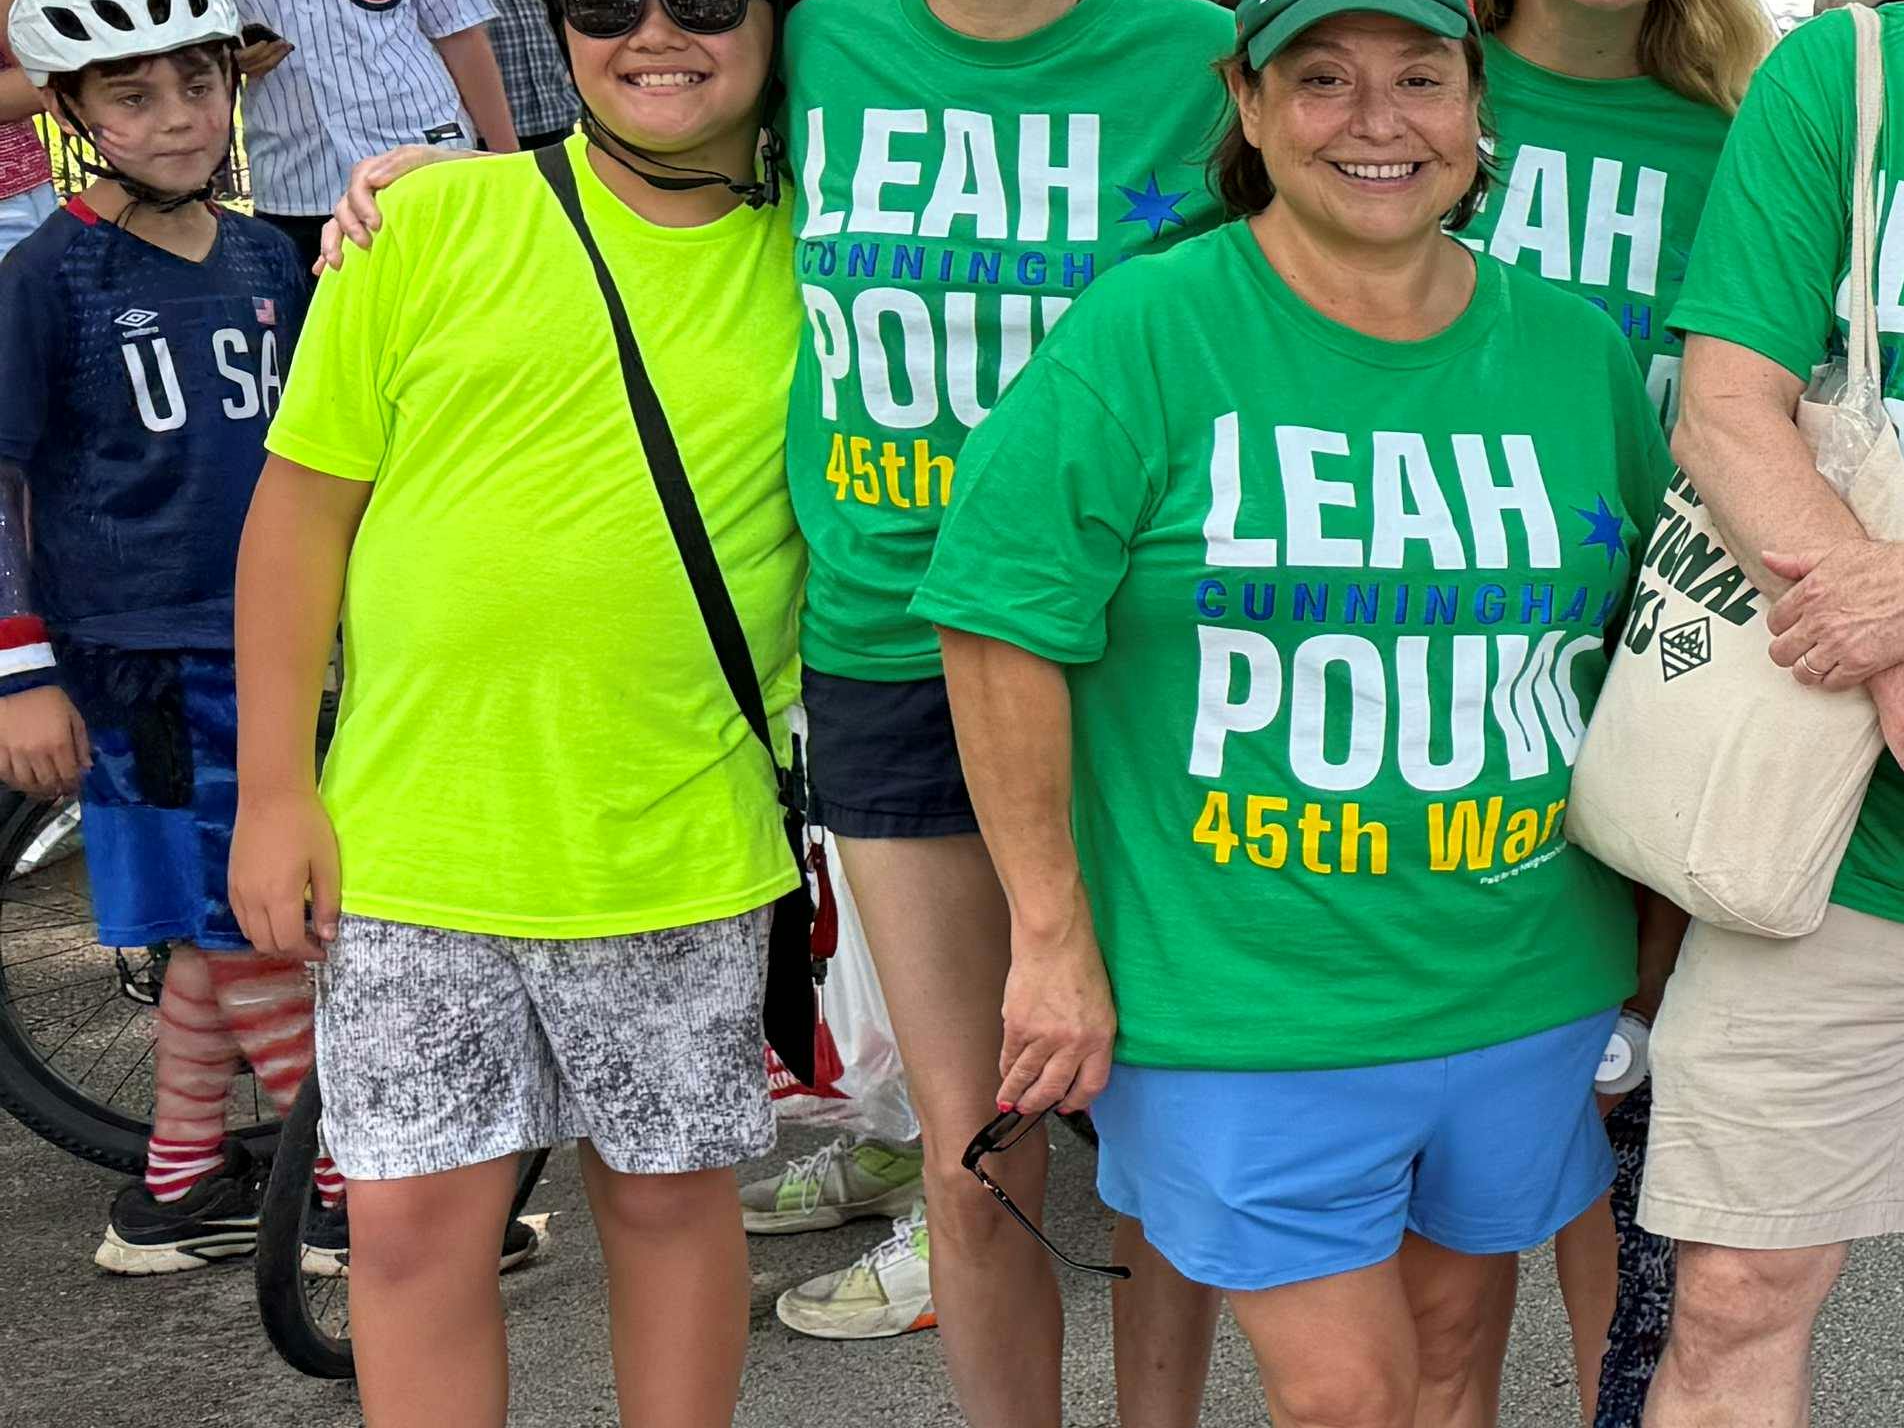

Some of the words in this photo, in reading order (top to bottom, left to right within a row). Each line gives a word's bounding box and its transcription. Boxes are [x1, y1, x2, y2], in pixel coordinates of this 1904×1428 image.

[800, 108, 1099, 241] LEAH
[1468, 144, 1668, 296] AH
[801, 241, 1098, 286] CUNNINGH
[826, 433, 956, 508] 45th
[1203, 411, 1561, 569] LEAH
[1193, 791, 1387, 875] 45th
[1428, 795, 1566, 872] War
